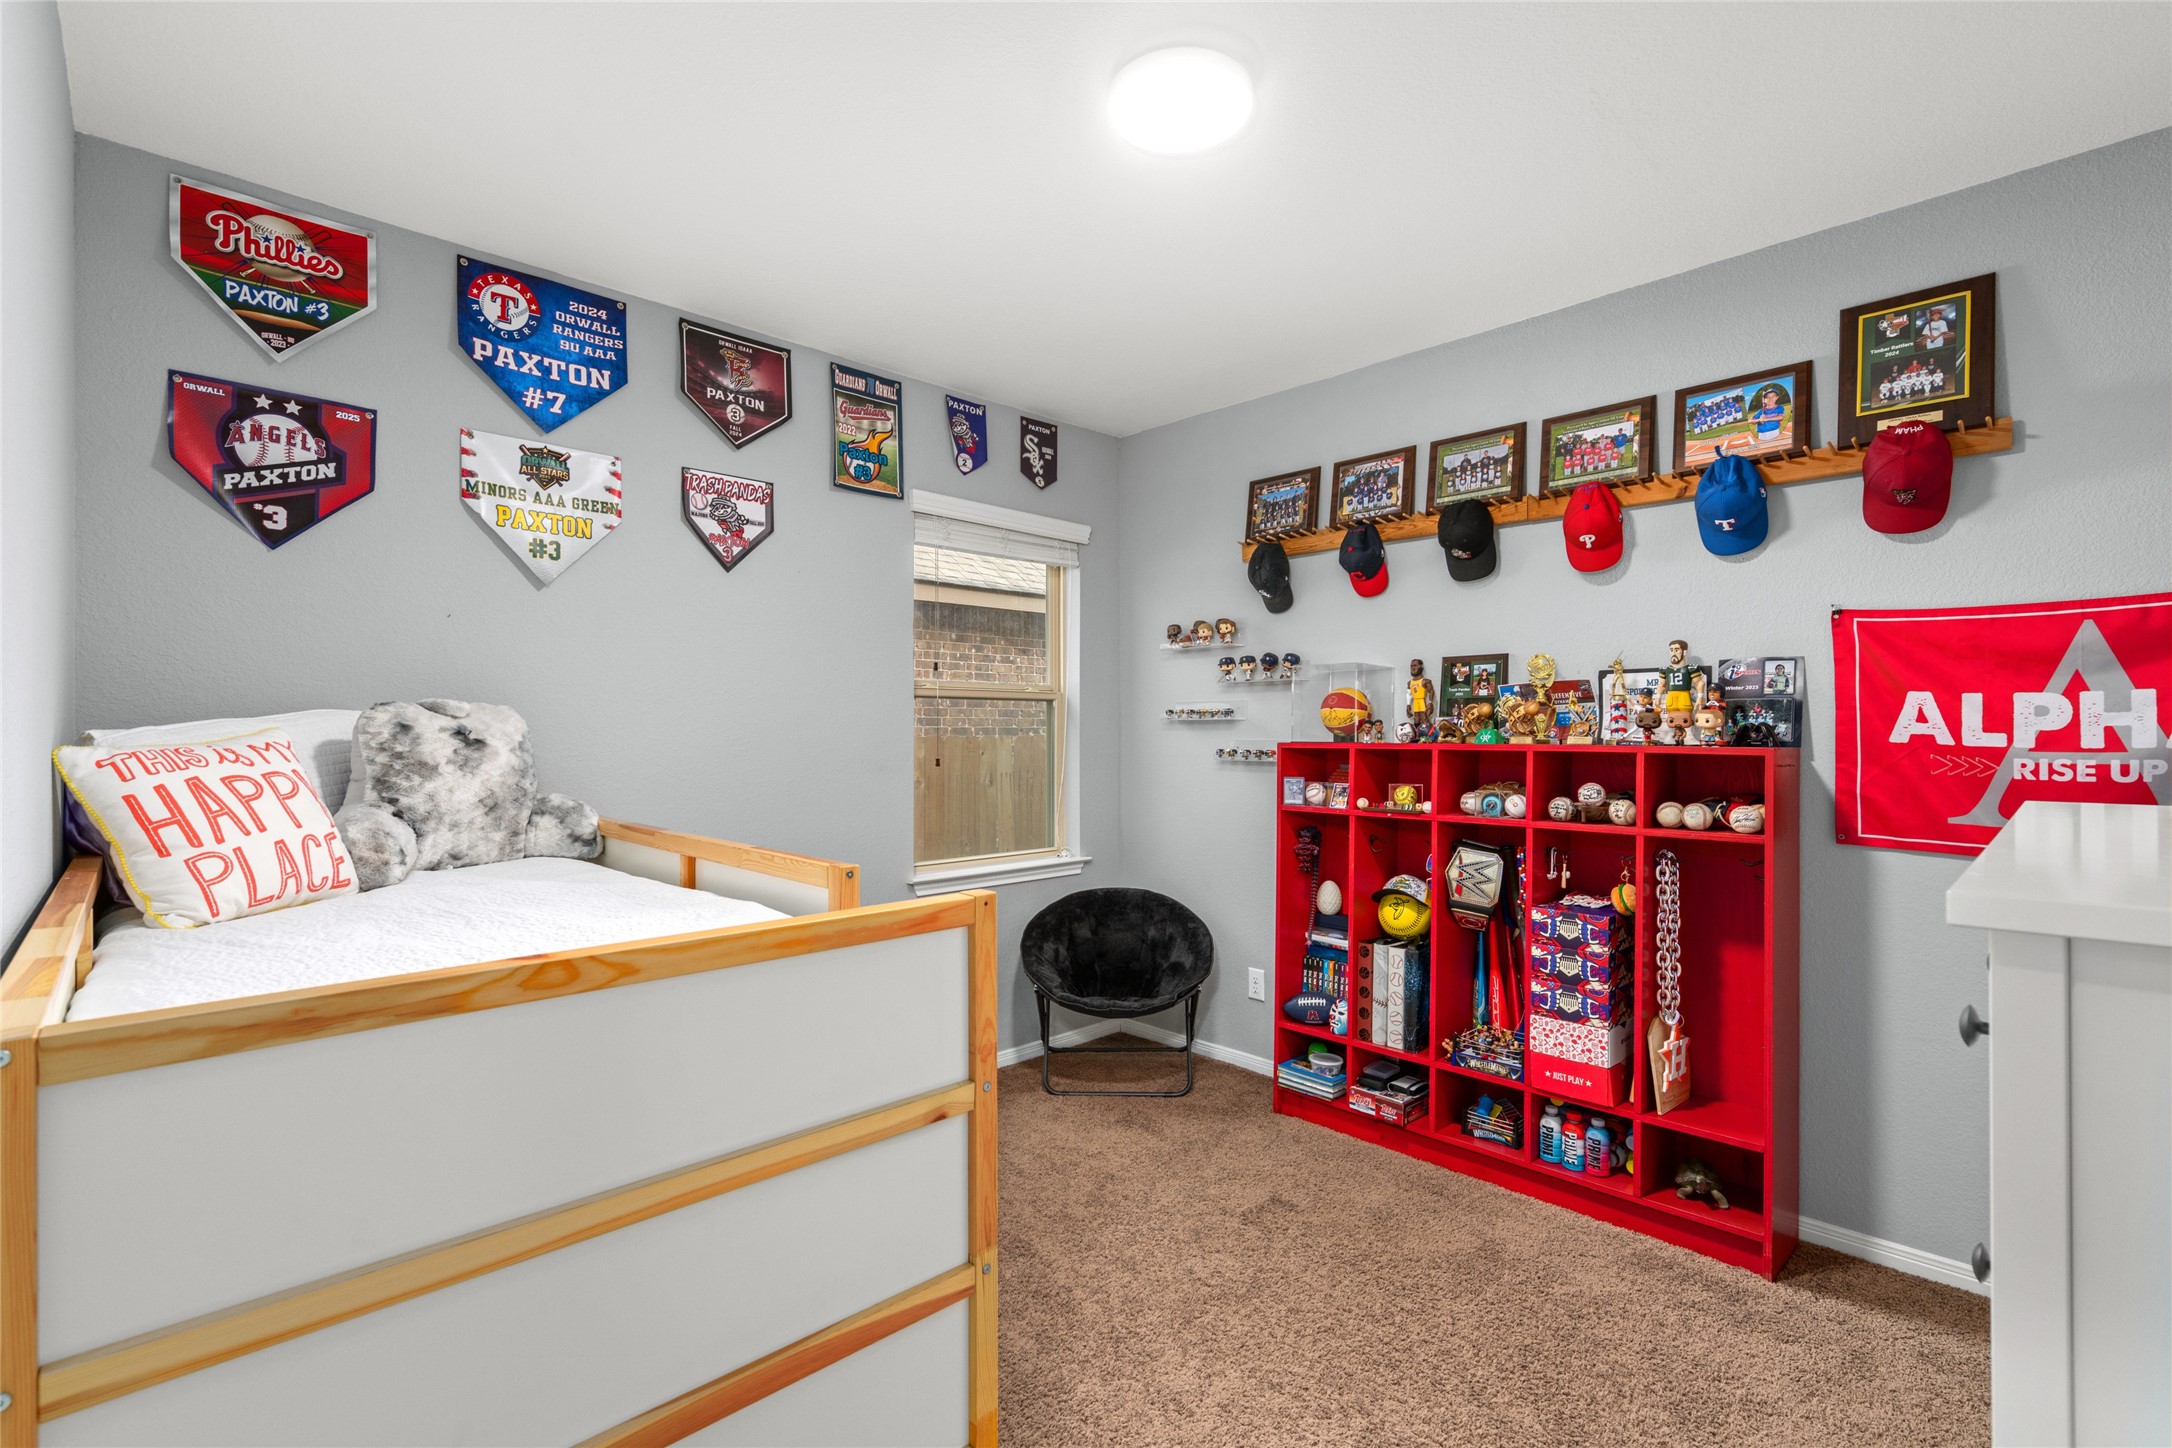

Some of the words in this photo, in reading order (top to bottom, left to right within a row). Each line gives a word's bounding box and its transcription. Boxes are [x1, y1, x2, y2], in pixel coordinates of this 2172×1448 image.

[206, 211, 344, 280] Phillies
[477, 274, 533, 300] TEXAS
[224, 280, 299, 314] PAXTON
[304, 303, 330, 321] #3
[490, 291, 520, 325] T
[569, 301, 608, 321] 2024
[471, 304, 538, 339] RANGERS
[555, 311, 621, 337] ORWALL
[270, 339, 287, 348] 2023
[552, 324, 624, 349] RANGERS
[472, 336, 611, 391] PAXTON
[583, 347, 617, 361] AAA
[183, 382, 226, 397] ORWALL
[834, 368, 866, 392] GUARDIANS
[875, 379, 898, 400] ORWALL
[521, 387, 567, 414] #7
[706, 386, 765, 412] PAXTON
[839, 399, 891, 421] Guardians
[947, 400, 983, 416] PAXTON
[335, 410, 361, 422] 2025
[730, 407, 741, 422] 3
[224, 420, 327, 459] ANGELS
[838, 422, 857, 437] 2022
[1028, 423, 1051, 435] PAXTON
[1895, 423, 1924, 435] PHAM
[838, 440, 889, 467] Paxton
[961, 459, 968, 467] 2
[223, 462, 337, 490] PAXTON
[520, 465, 539, 474] ALL
[540, 467, 569, 481] STARS
[853, 463, 872, 481] #3
[464, 478, 527, 502] MINORS
[532, 491, 566, 508] AAA
[571, 497, 620, 515] GREEN
[684, 472, 723, 496] TRASH
[723, 480, 773, 505] PANDAS
[252, 502, 288, 531] #3
[495, 504, 594, 540] PAXTON
[1714, 518, 1738, 532] T
[528, 537, 562, 562] #3
[708, 532, 751, 549] PAXTON
[1579, 533, 1597, 550] P
[722, 546, 733, 563] 3
[1669, 672, 1683, 686] 12
[1551, 690, 1583, 700] DEFENIVE
[1888, 688, 2172, 750] ALPH
[96, 746, 210, 783] THIS
[207, 744, 255, 767] is
[247, 739, 302, 765] MY
[2012, 757, 2098, 783] RISE
[2110, 758, 2170, 783] UP
[121, 768, 336, 859] HAPPY
[183, 831, 352, 920] PLACE
[1668, 1036, 1691, 1082] H
[1552, 1071, 1568, 1083] JUST
[1567, 1074, 1585, 1087] PLAY
[1541, 1124, 1554, 1157] PRIME
[1564, 1130, 1578, 1165] PRIME
[1587, 1136, 1602, 1170] PRIME
